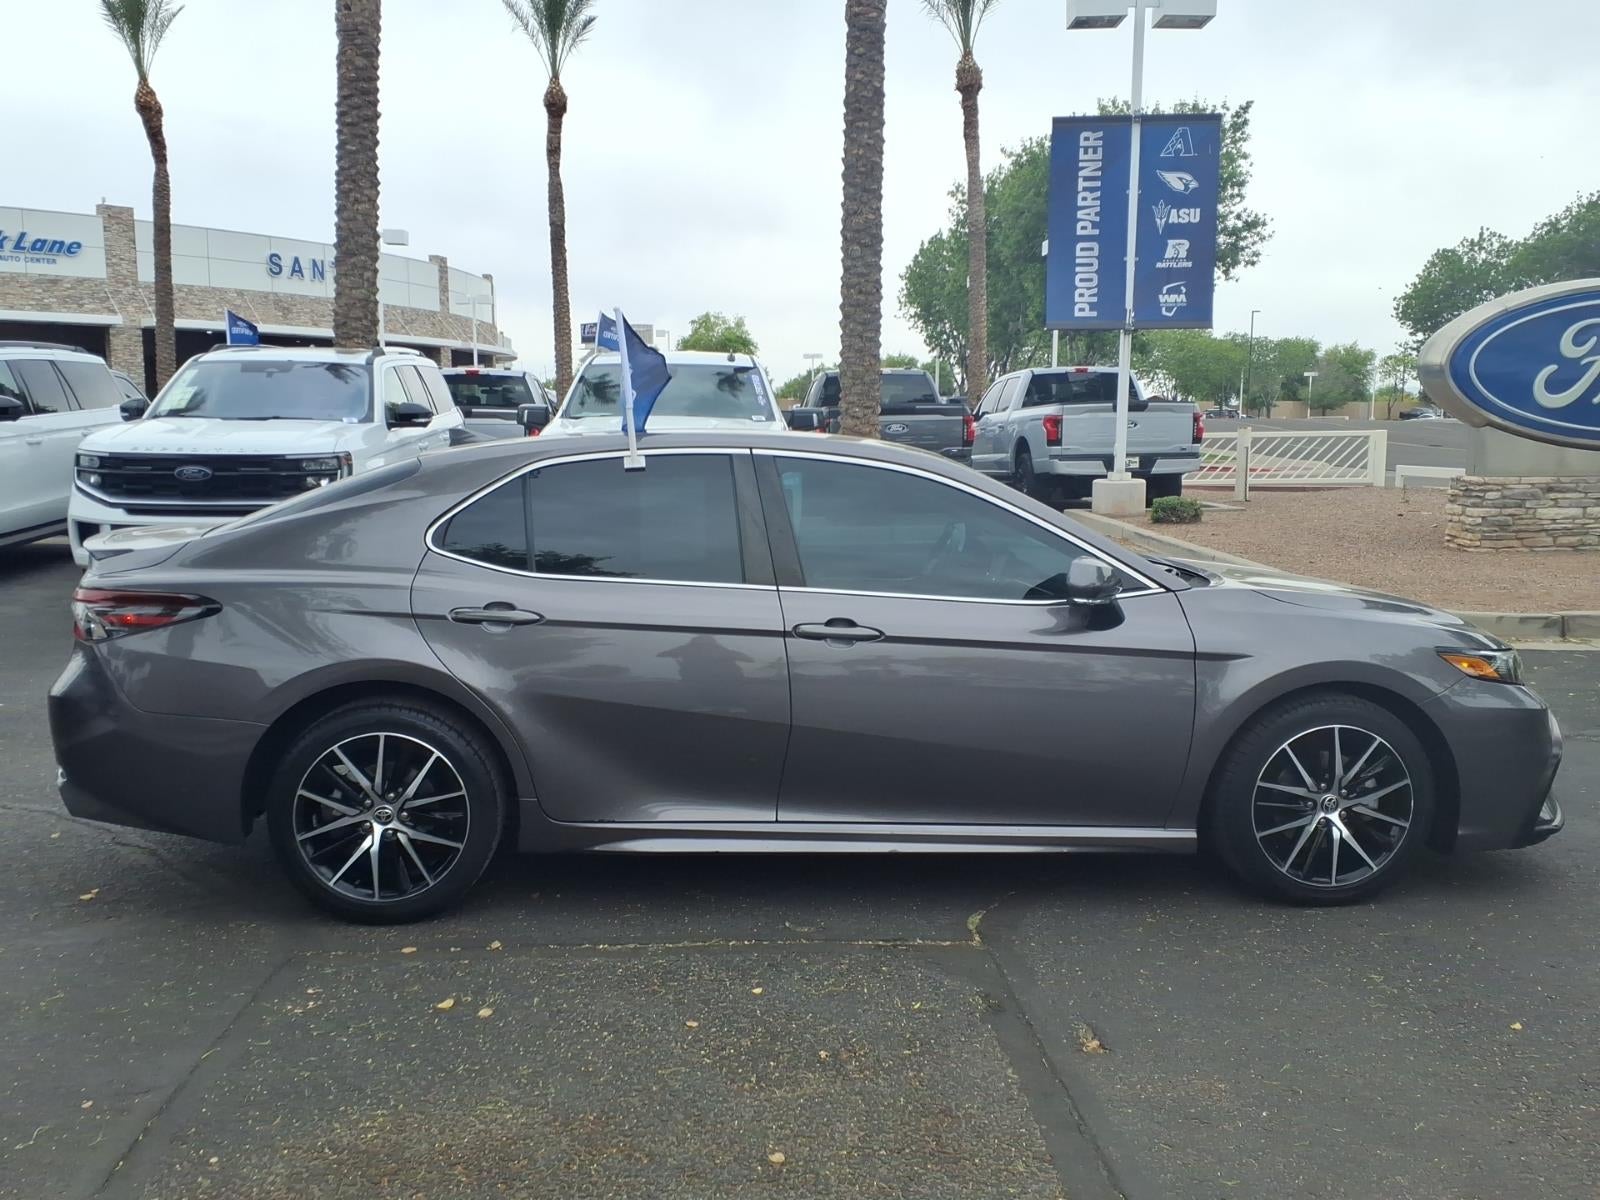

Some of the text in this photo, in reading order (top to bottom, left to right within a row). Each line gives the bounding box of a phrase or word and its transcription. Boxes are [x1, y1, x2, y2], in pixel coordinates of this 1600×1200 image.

[1074, 131, 1104, 317] PROUD PARTNER
[1168, 208, 1201, 224] ASU
[13, 231, 82, 256] Lane
[24, 256, 57, 265] CENTER
[1155, 261, 1193, 269] RATTLERS
